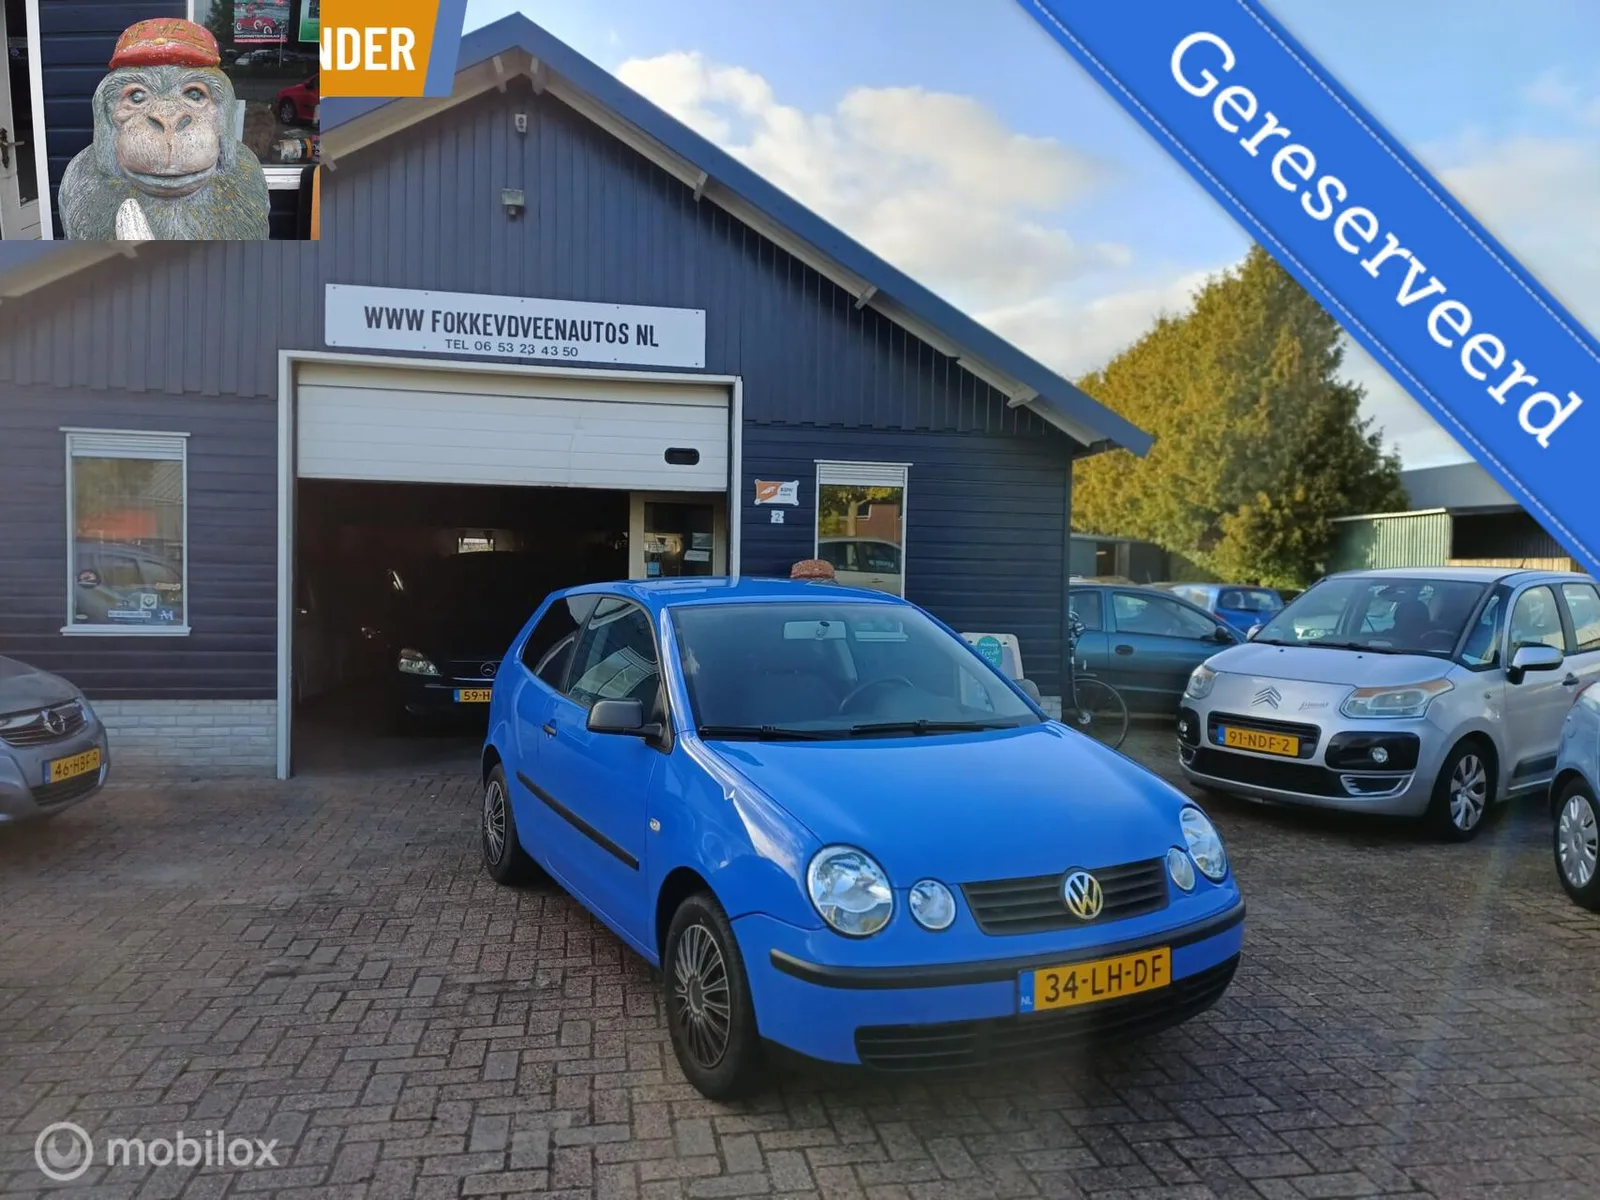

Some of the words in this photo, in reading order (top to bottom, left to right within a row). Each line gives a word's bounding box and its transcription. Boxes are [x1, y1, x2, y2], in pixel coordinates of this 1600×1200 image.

[364, 305, 425, 331] WWW
[431, 310, 629, 345] FOKKEVDVEENAUTOS
[636, 323, 659, 348] NL
[445, 338, 469, 350] TEL
[474, 340, 492, 351] 06
[498, 342, 514, 353] 53
[520, 343, 536, 355] 23
[541, 345, 559, 356] 43
[562, 346, 579, 357] 50
[774, 512, 781, 522] 2
[1229, 730, 1291, 753] 91-NDF-2
[1044, 953, 1163, 1003] 34-LH-DF
[1020, 996, 1033, 1006] NL
